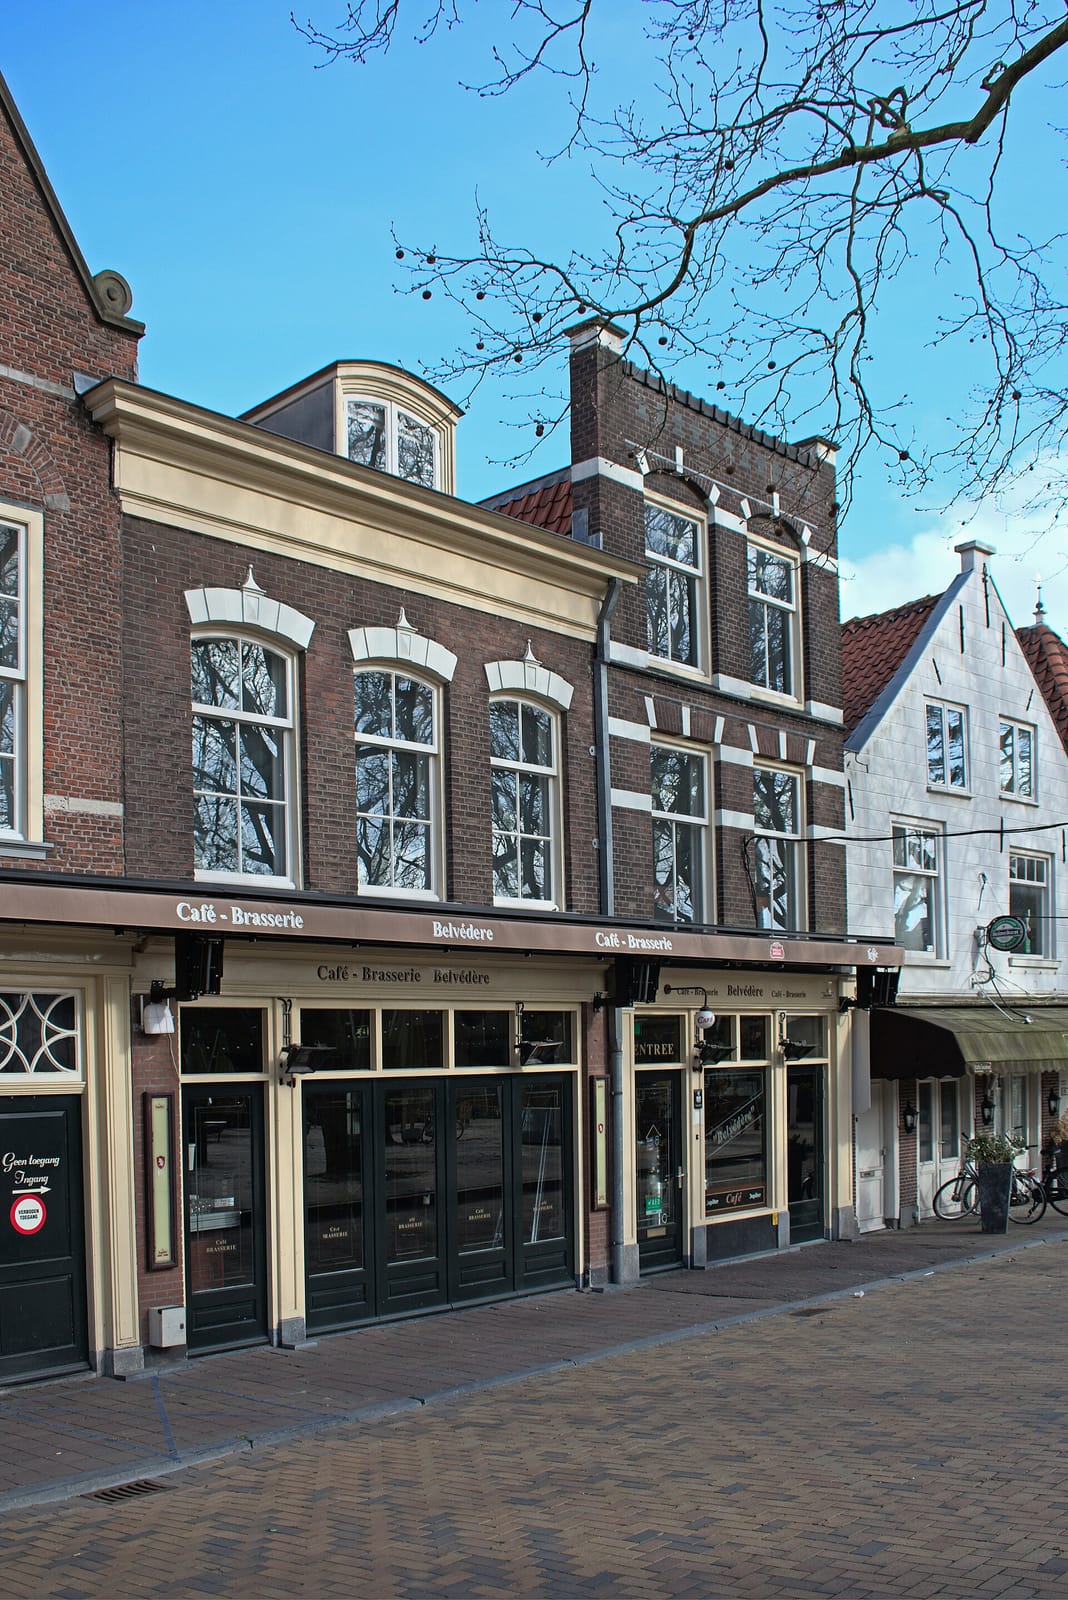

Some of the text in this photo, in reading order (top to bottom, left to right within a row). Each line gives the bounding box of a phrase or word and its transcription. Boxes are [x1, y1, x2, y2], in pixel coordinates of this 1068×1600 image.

[176, 902, 217, 923] Café
[230, 905, 304, 929] Brasserie
[595, 931, 620, 948] Café
[627, 934, 673, 951] Brasserie
[317, 965, 349, 982] Café
[361, 966, 422, 983] Brasserie
[433, 968, 490, 985] Belvédère
[727, 984, 764, 997] Belvédère
[2, 1152, 60, 1173] Geen toegang
